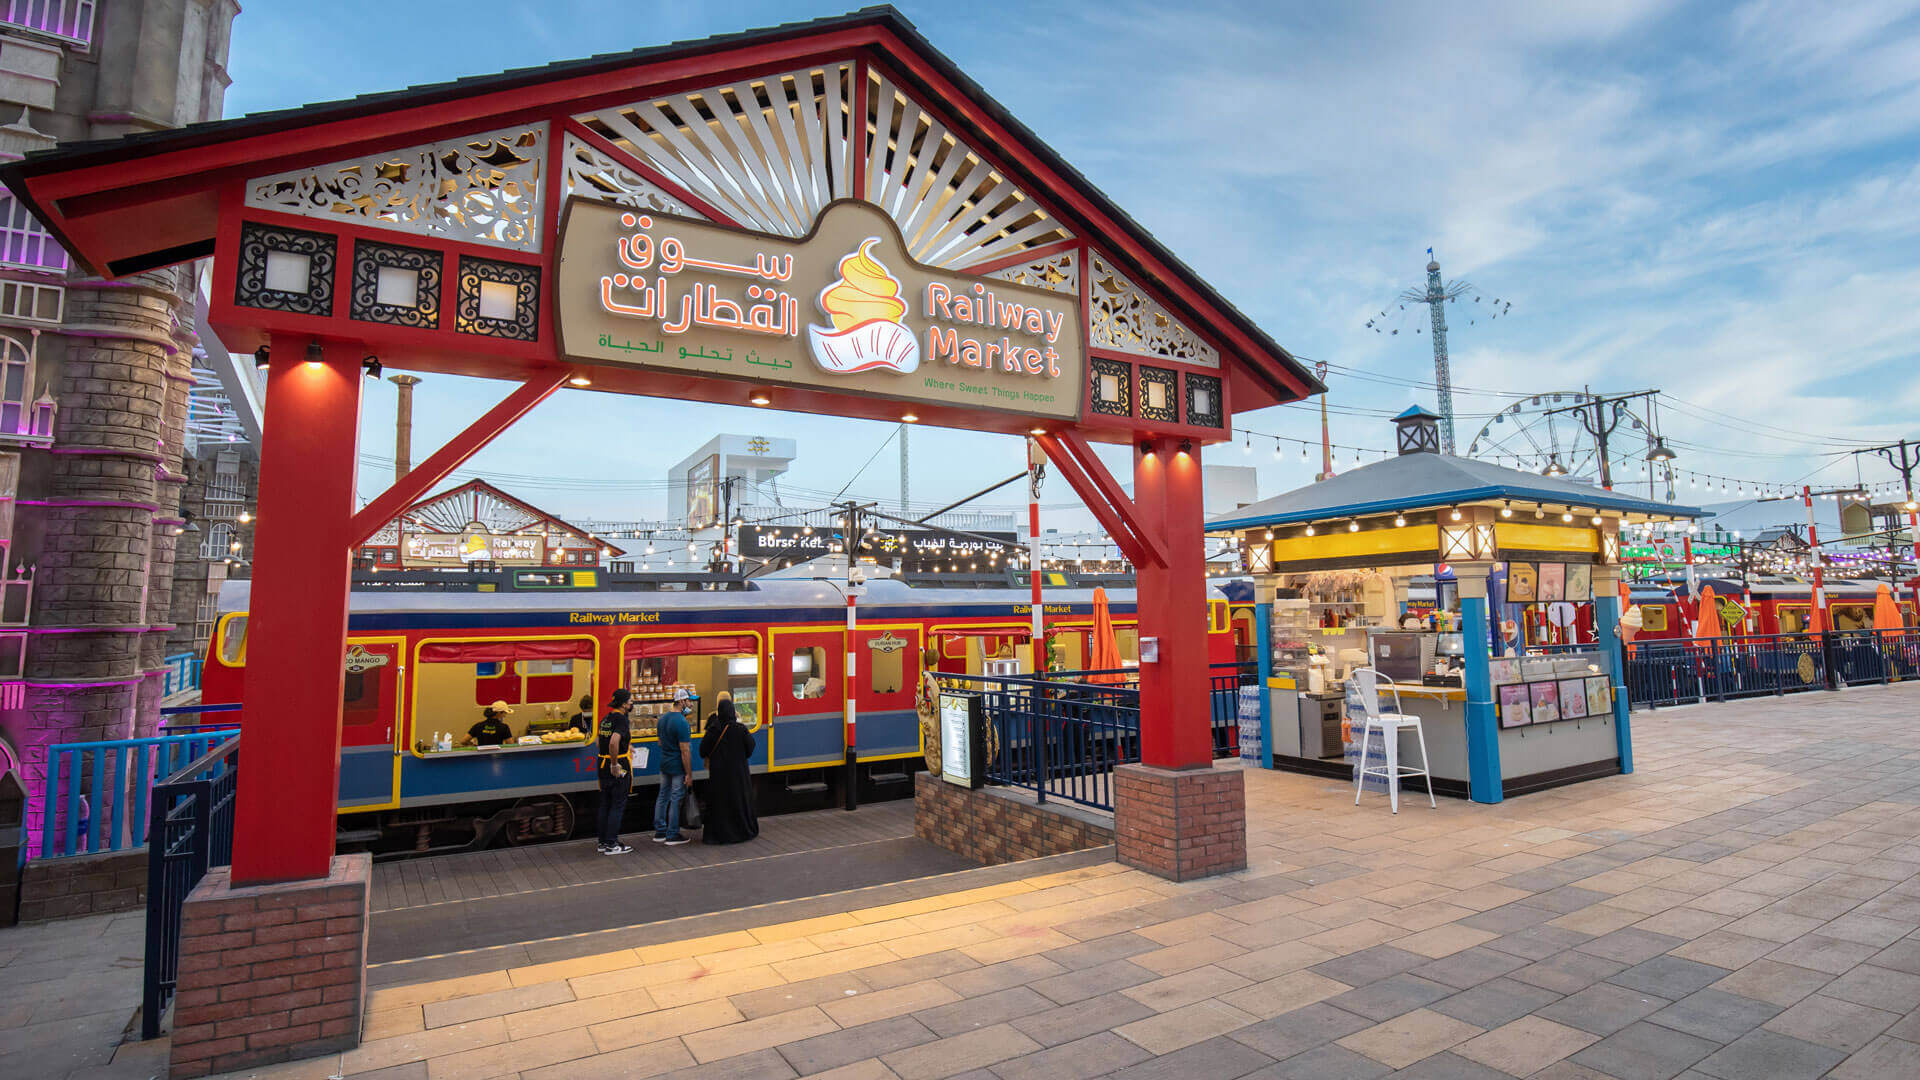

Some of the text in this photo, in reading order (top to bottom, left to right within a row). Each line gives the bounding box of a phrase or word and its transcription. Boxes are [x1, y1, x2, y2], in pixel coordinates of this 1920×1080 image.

[618, 213, 794, 281] سوق
[601, 273, 798, 336] القطارات
[928, 282, 1064, 343] Railway
[598, 334, 793, 370] حيث تحلو الحياة
[929, 326, 1061, 377] Market
[924, 377, 1055, 402] Where Sweet Things Happen
[569, 612, 660, 625] Railway Market
[1044, 604, 1072, 613] Market
